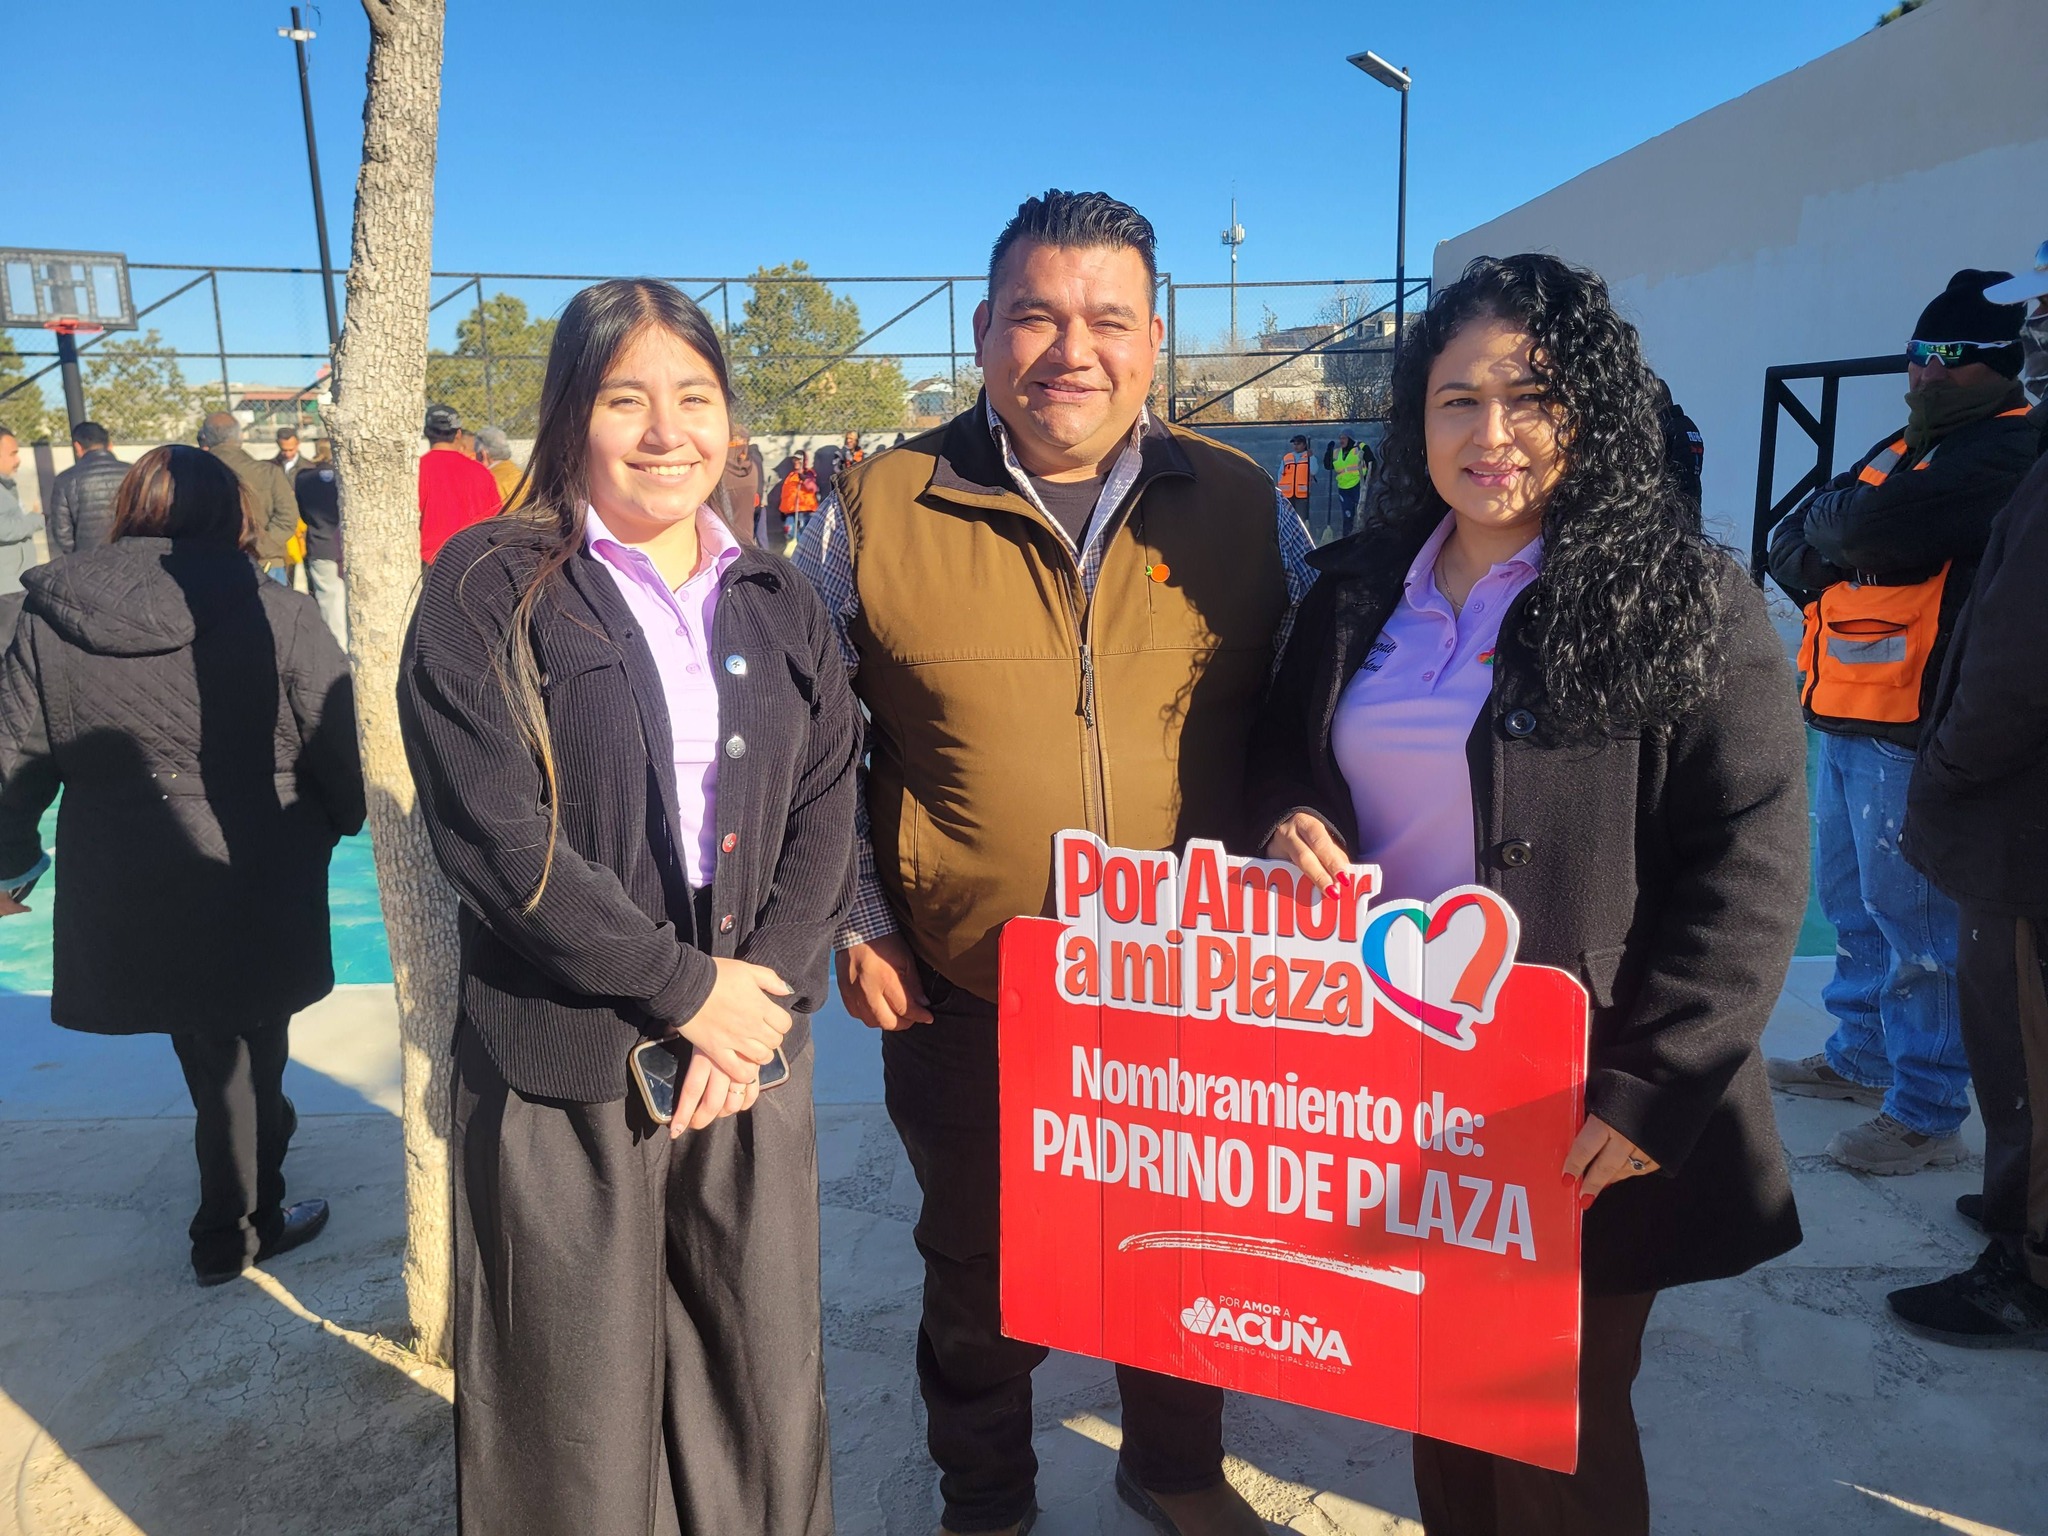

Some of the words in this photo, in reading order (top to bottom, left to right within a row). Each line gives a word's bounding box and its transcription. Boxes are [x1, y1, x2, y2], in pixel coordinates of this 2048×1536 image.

[1063, 838, 1168, 925] Por
[1180, 847, 1372, 942] Amor
[1064, 935, 1099, 997] a
[1111, 930, 1183, 1007] mi
[1196, 934, 1363, 1027] Plaza
[1071, 1045, 1402, 1144] Nombramiento
[1414, 1091, 1485, 1157] de:
[1033, 1108, 1254, 1208] PADRINO
[1267, 1145, 1334, 1223] DE
[1347, 1157, 1537, 1262] PLAZA
[1208, 1307, 1352, 1366] ACUÑA
[1219, 1295, 1240, 1308] POR
[1242, 1301, 1281, 1316] AMOR
[1283, 1308, 1291, 1318] A
[1213, 1341, 1256, 1355] GOBIERNO
[1258, 1350, 1303, 1366] MUNICIPAL
[1304, 1360, 1347, 1375] 2025-2027
